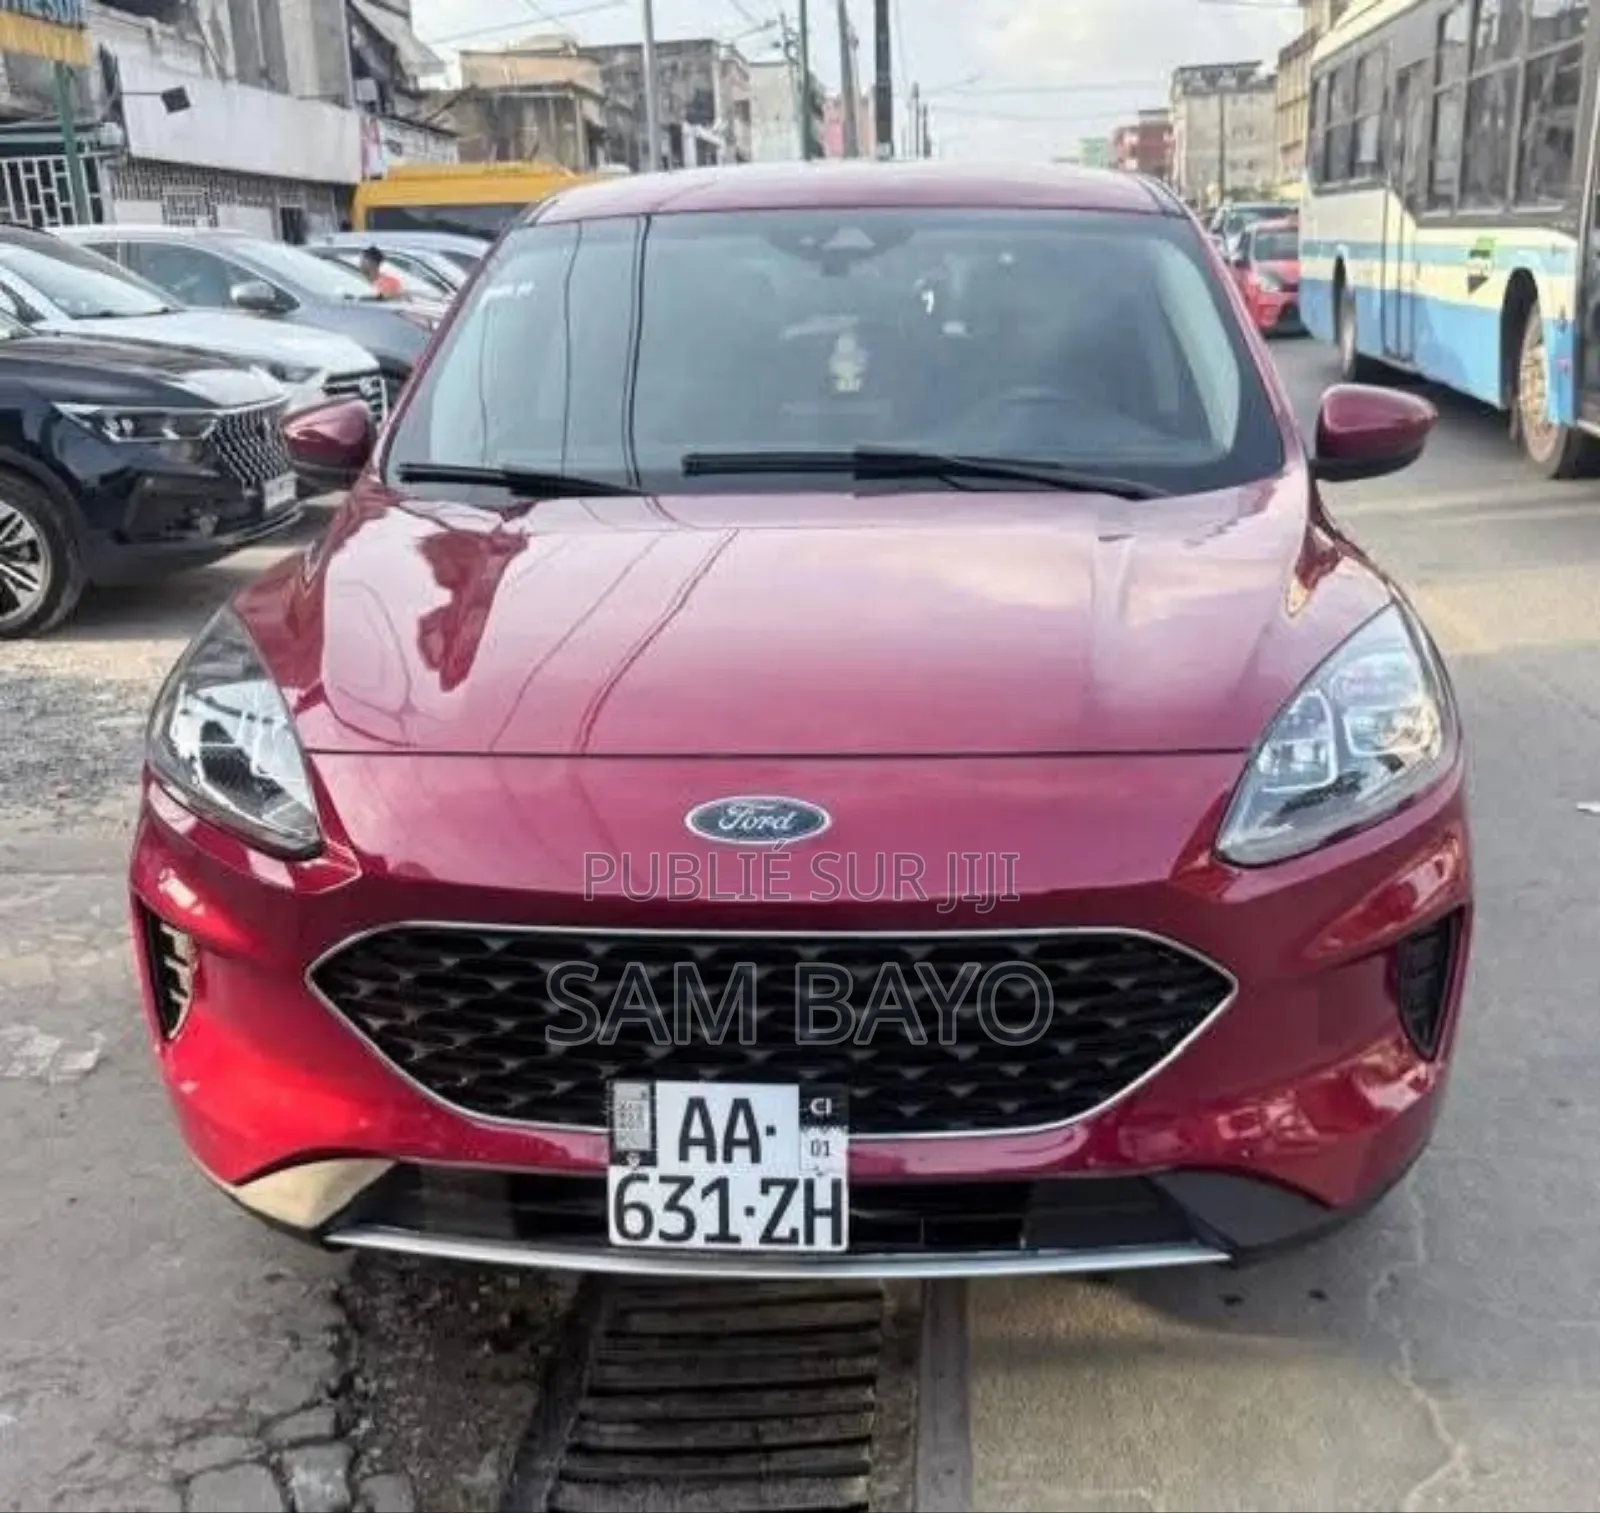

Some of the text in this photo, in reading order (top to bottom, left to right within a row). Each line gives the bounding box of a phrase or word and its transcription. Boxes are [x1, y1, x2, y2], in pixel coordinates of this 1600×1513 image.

[718, 802, 798, 830] Ford
[810, 1098, 833, 1115] CI
[810, 1139, 831, 1158] 01
